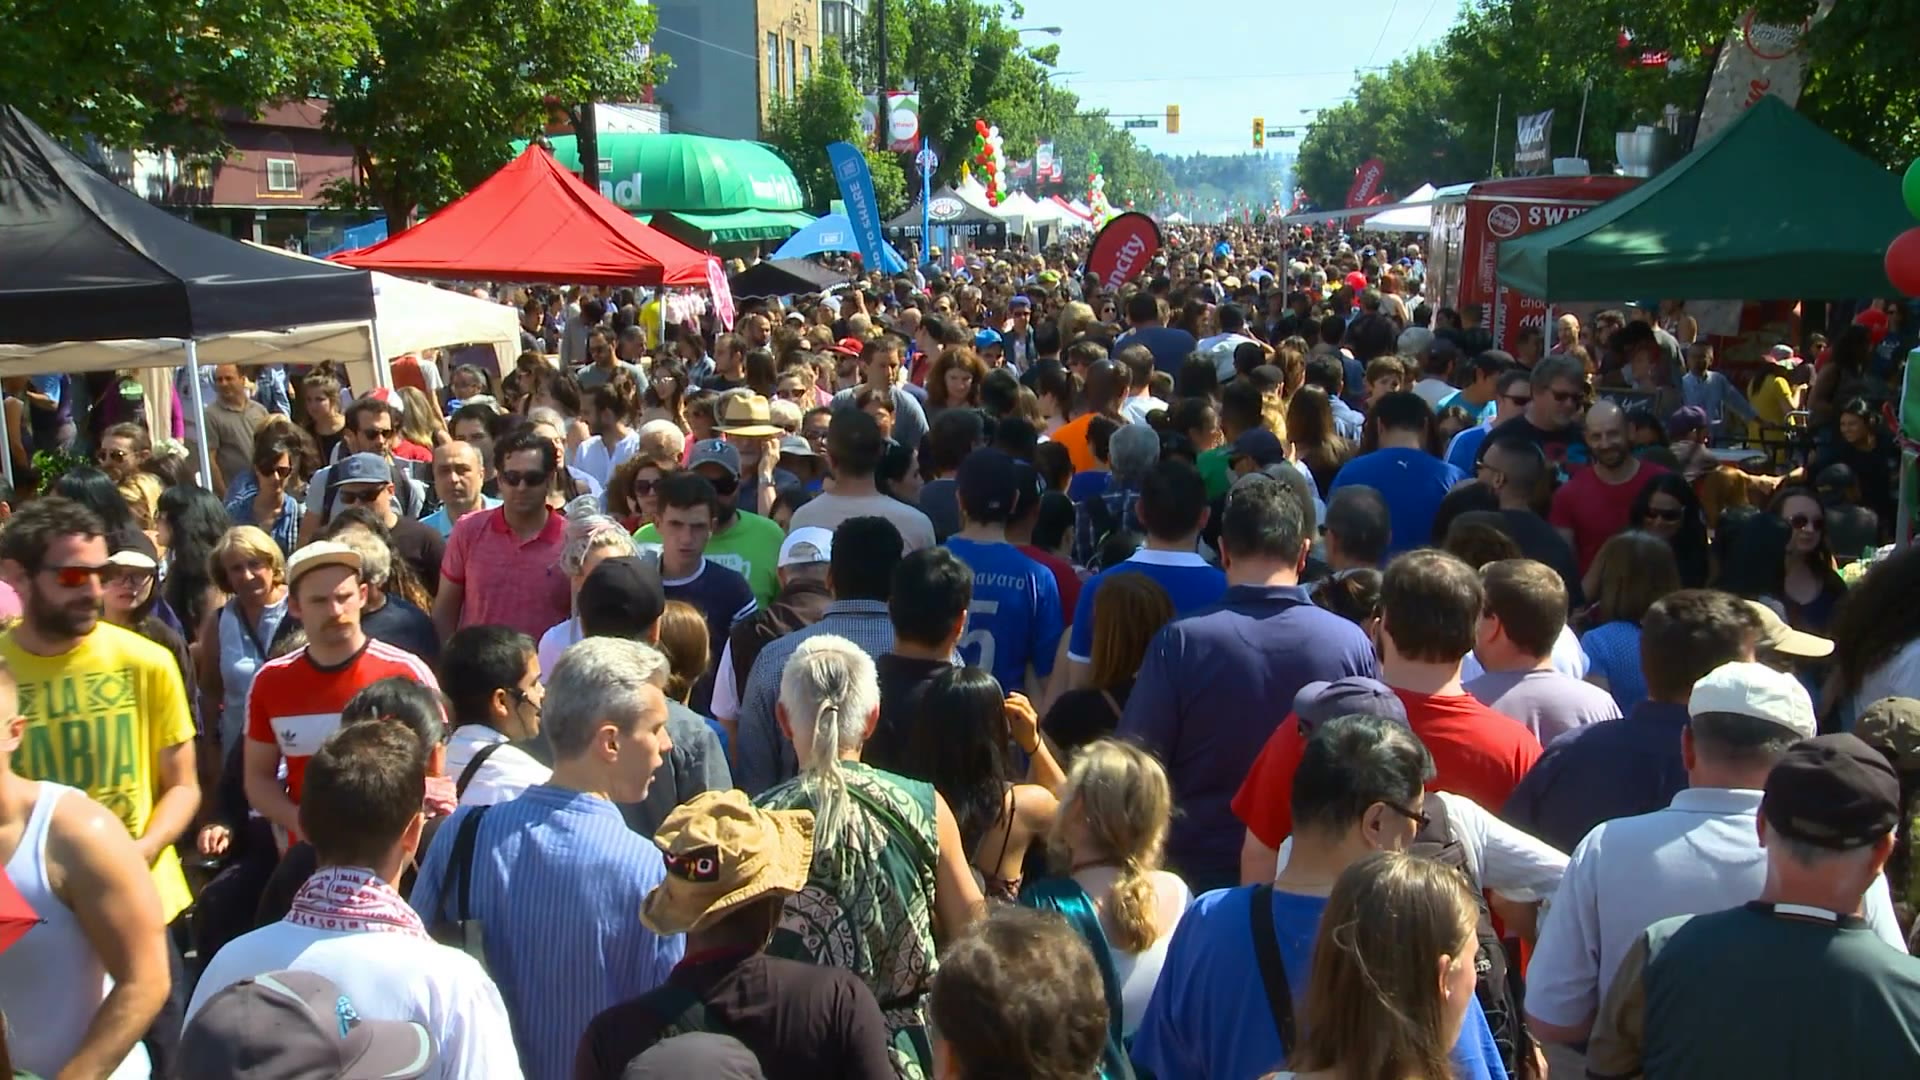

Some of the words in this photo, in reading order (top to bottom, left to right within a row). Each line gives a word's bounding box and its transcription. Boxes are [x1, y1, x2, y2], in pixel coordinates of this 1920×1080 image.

[849, 181, 872, 229] SHARE
[1528, 206, 1589, 226] SWE
[951, 224, 981, 236] THIRST
[44, 676, 80, 720] LA
